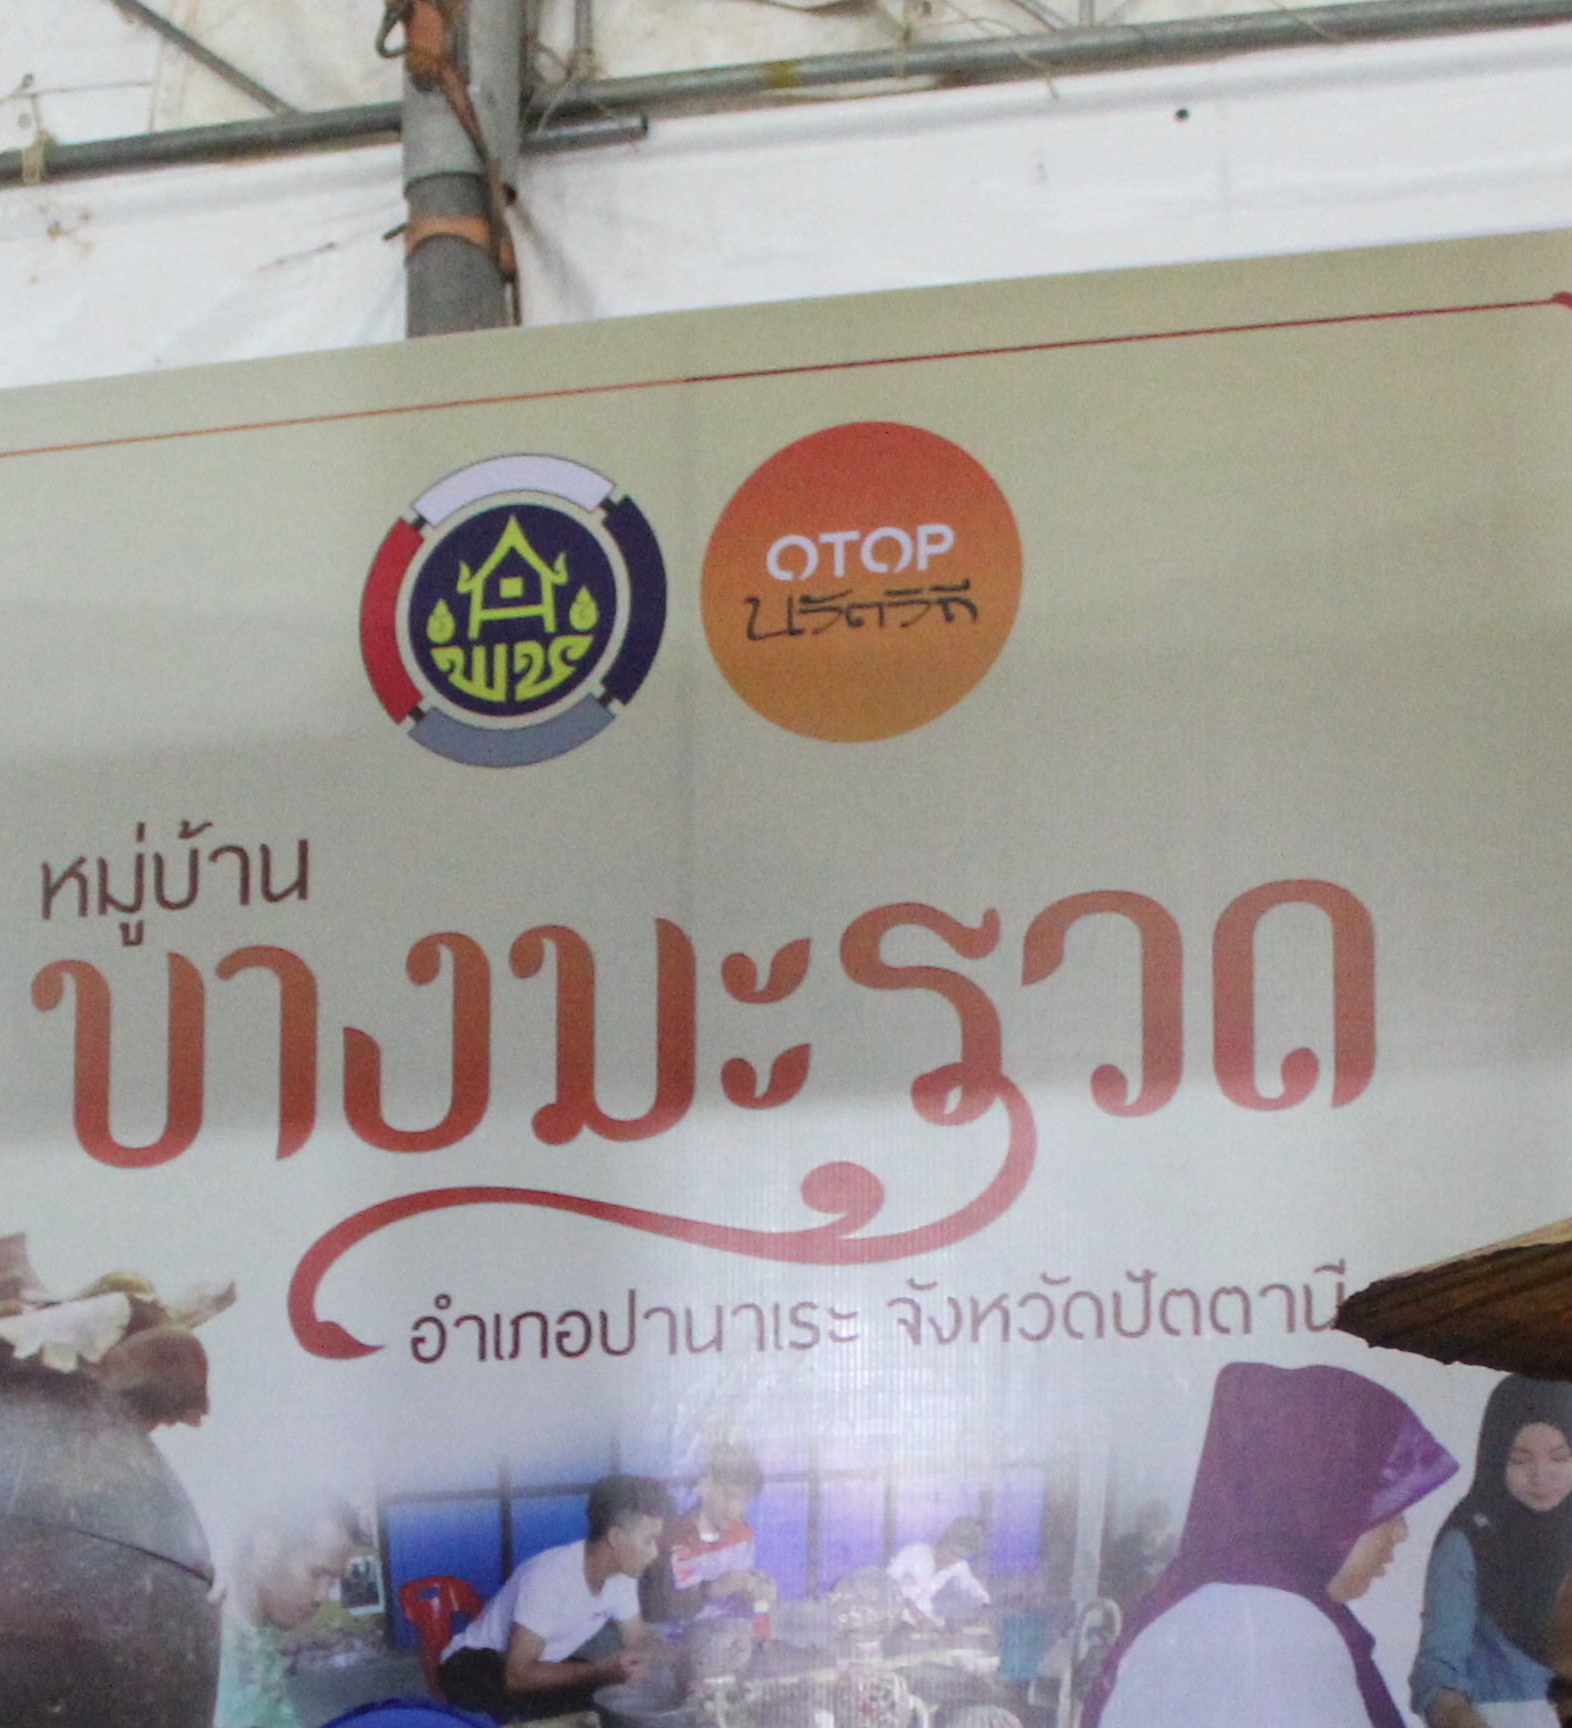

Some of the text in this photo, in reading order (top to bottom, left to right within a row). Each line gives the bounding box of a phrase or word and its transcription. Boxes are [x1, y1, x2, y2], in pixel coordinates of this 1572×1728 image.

[765, 522, 955, 582] OTOP
[36, 820, 313, 947] หมู่บ้าน
[27, 876, 1379, 1265] บางมะรวด
[409, 1258, 1349, 1364] อำเภอปานาเระ จังหวัดปัตตานี
